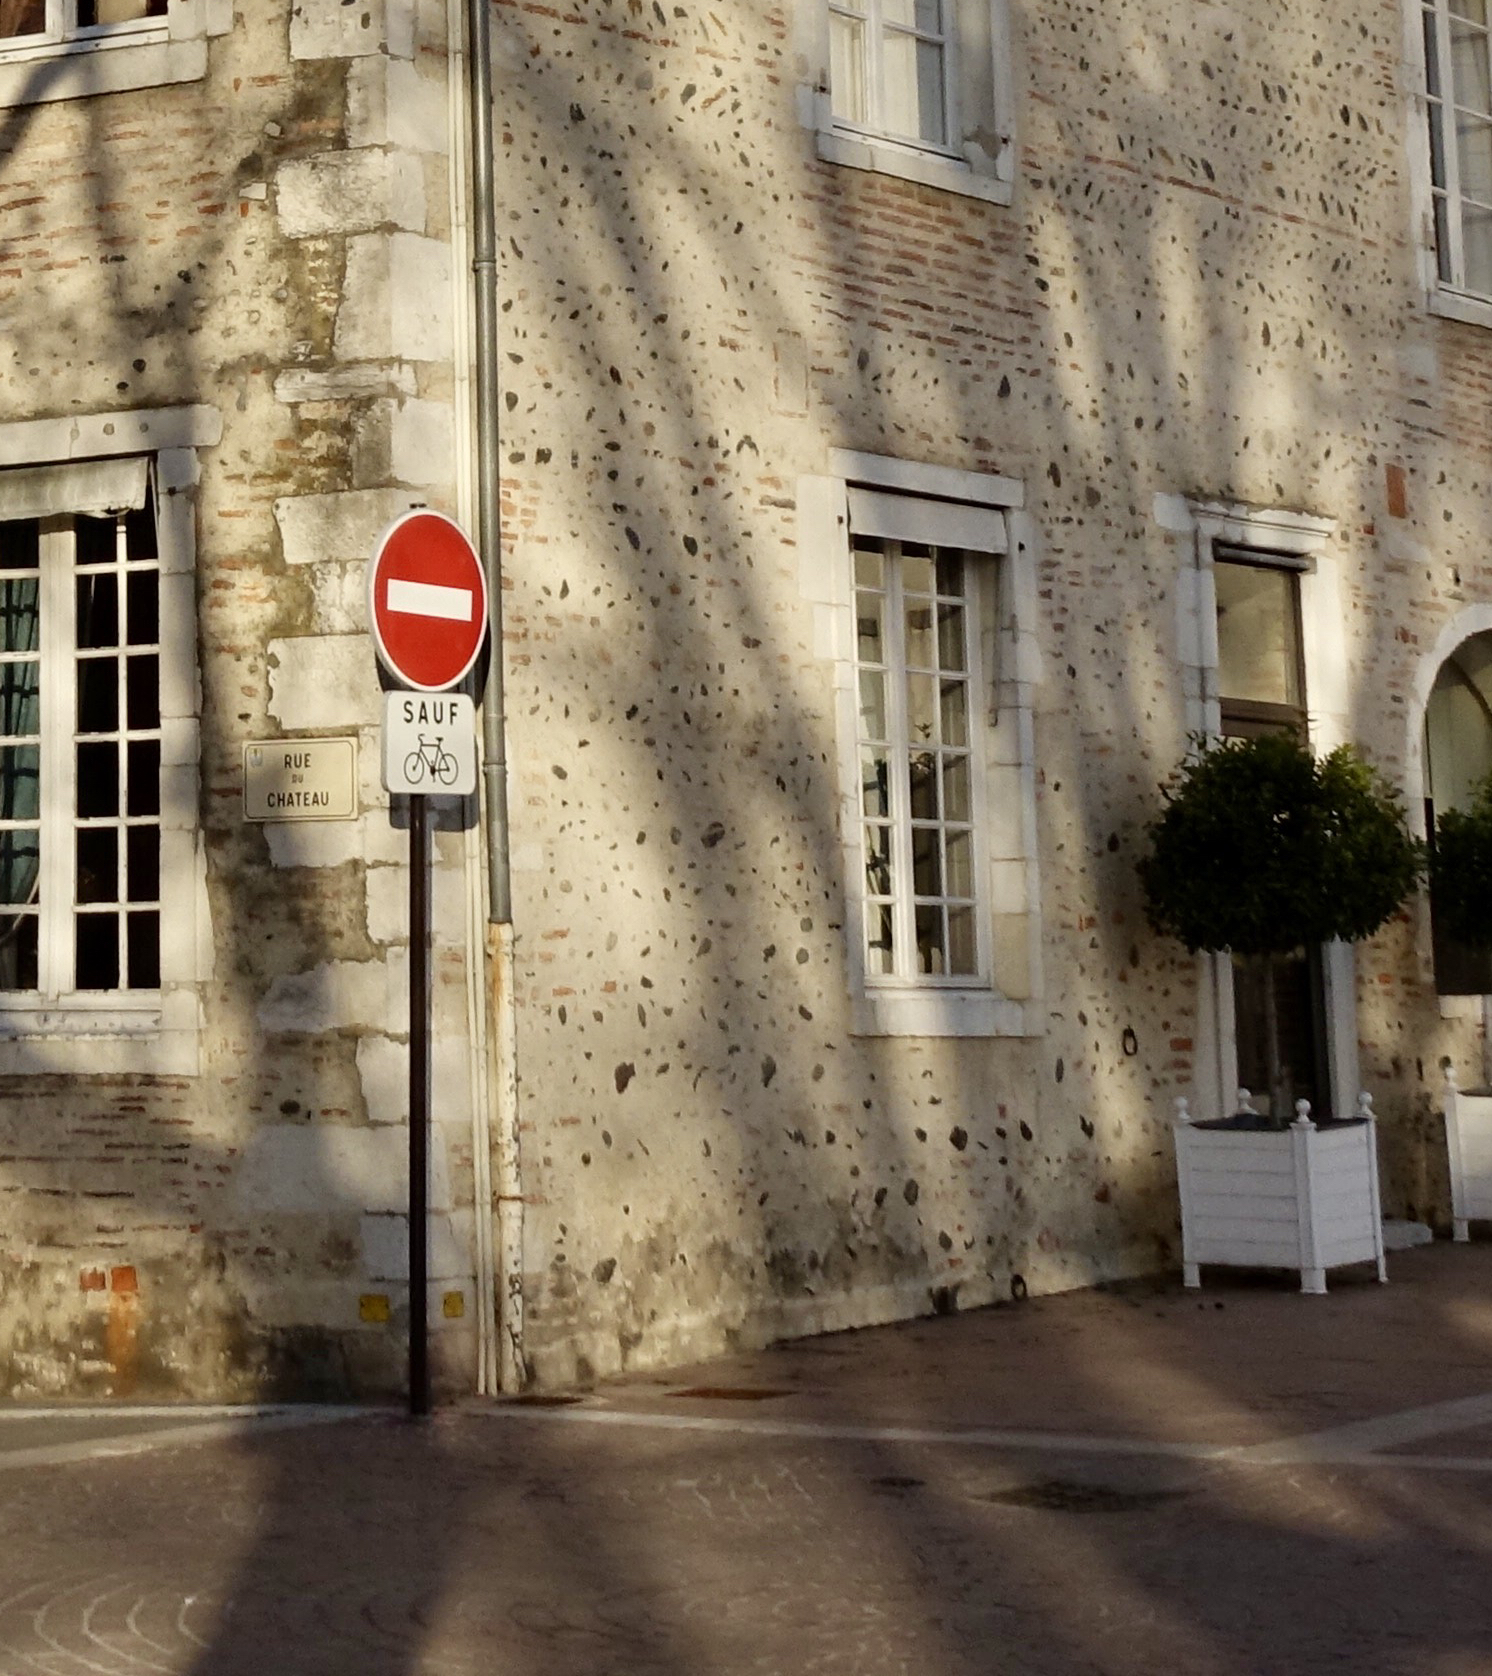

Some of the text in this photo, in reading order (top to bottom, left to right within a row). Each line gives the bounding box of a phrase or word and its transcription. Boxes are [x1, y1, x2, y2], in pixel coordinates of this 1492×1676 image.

[403, 700, 460, 726] SAUF
[284, 753, 312, 769] RUE
[291, 773, 304, 784] DU
[267, 791, 329, 808] CHATEAU
